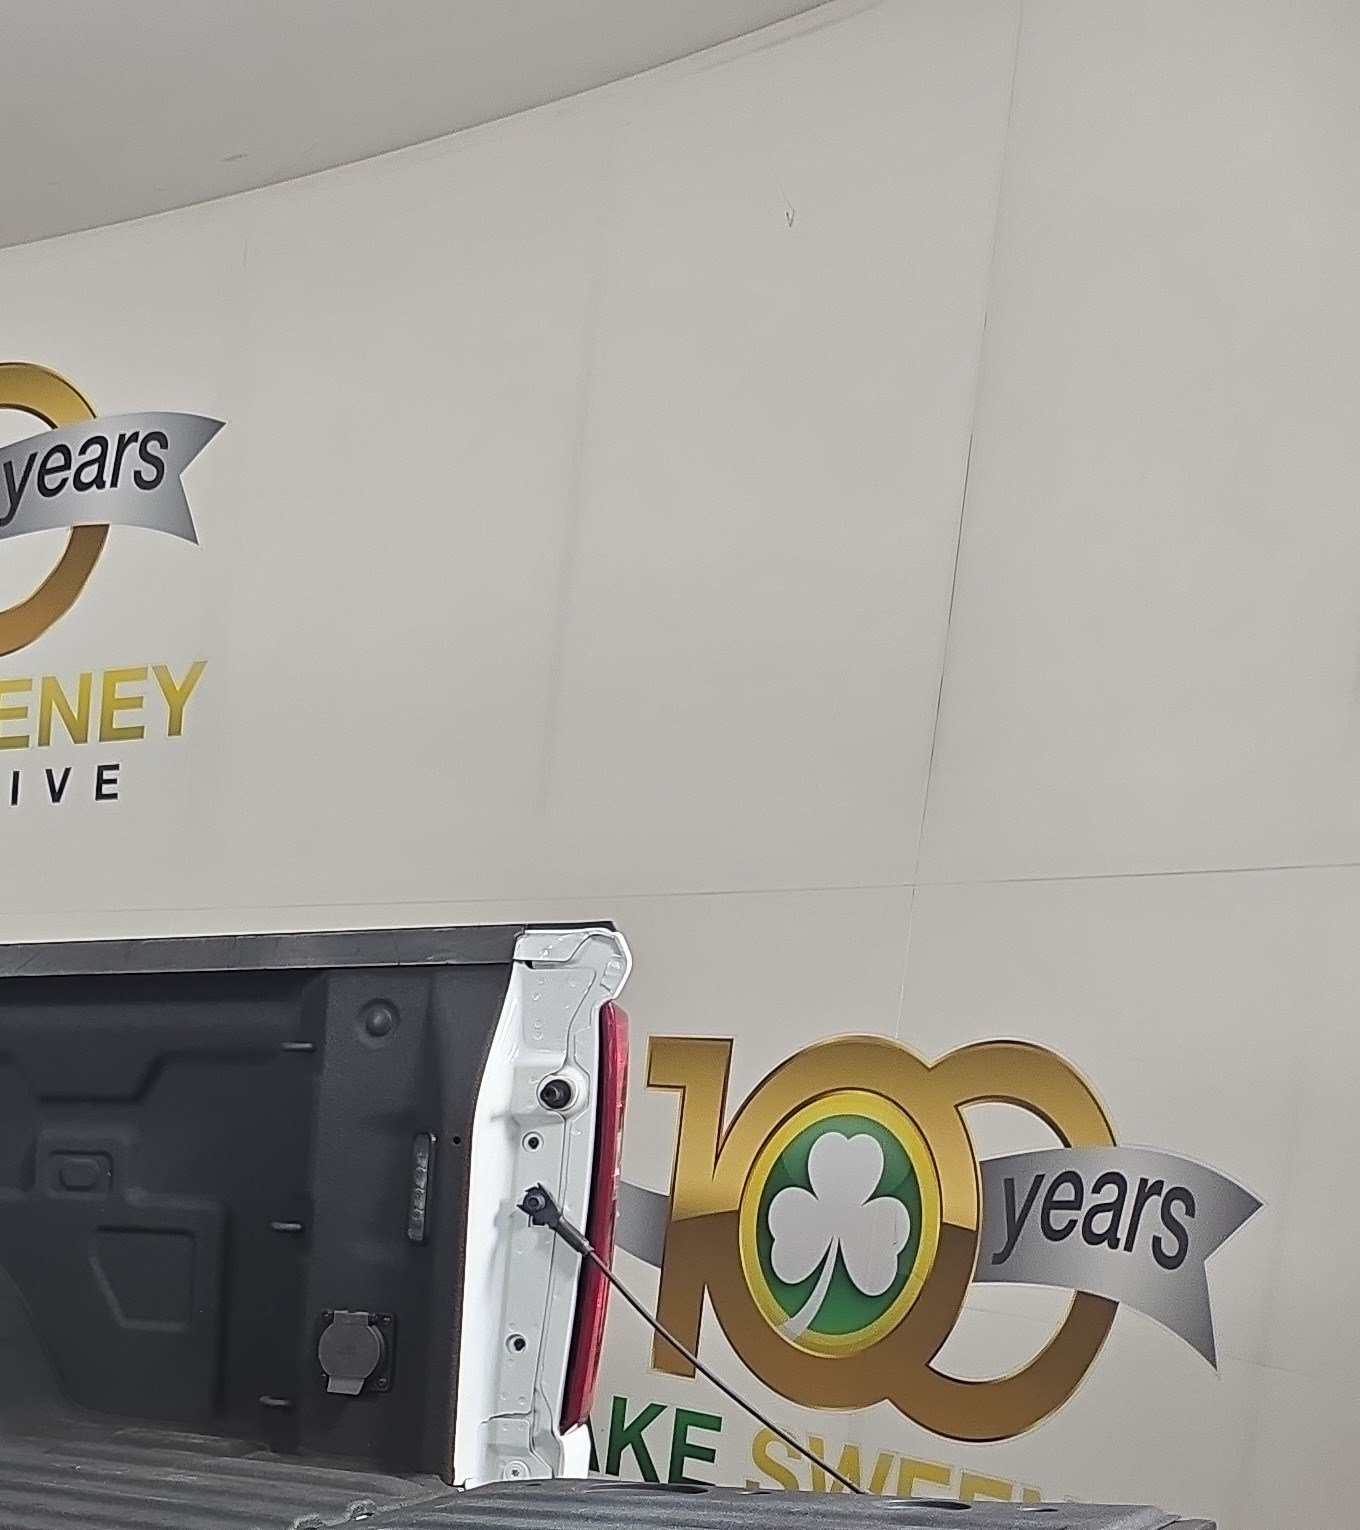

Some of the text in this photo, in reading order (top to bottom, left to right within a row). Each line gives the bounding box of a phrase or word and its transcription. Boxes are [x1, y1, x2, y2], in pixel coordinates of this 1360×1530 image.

[0, 430, 168, 526] years
[647, 1033, 1119, 1443] 100
[991, 1171, 1197, 1271] years
